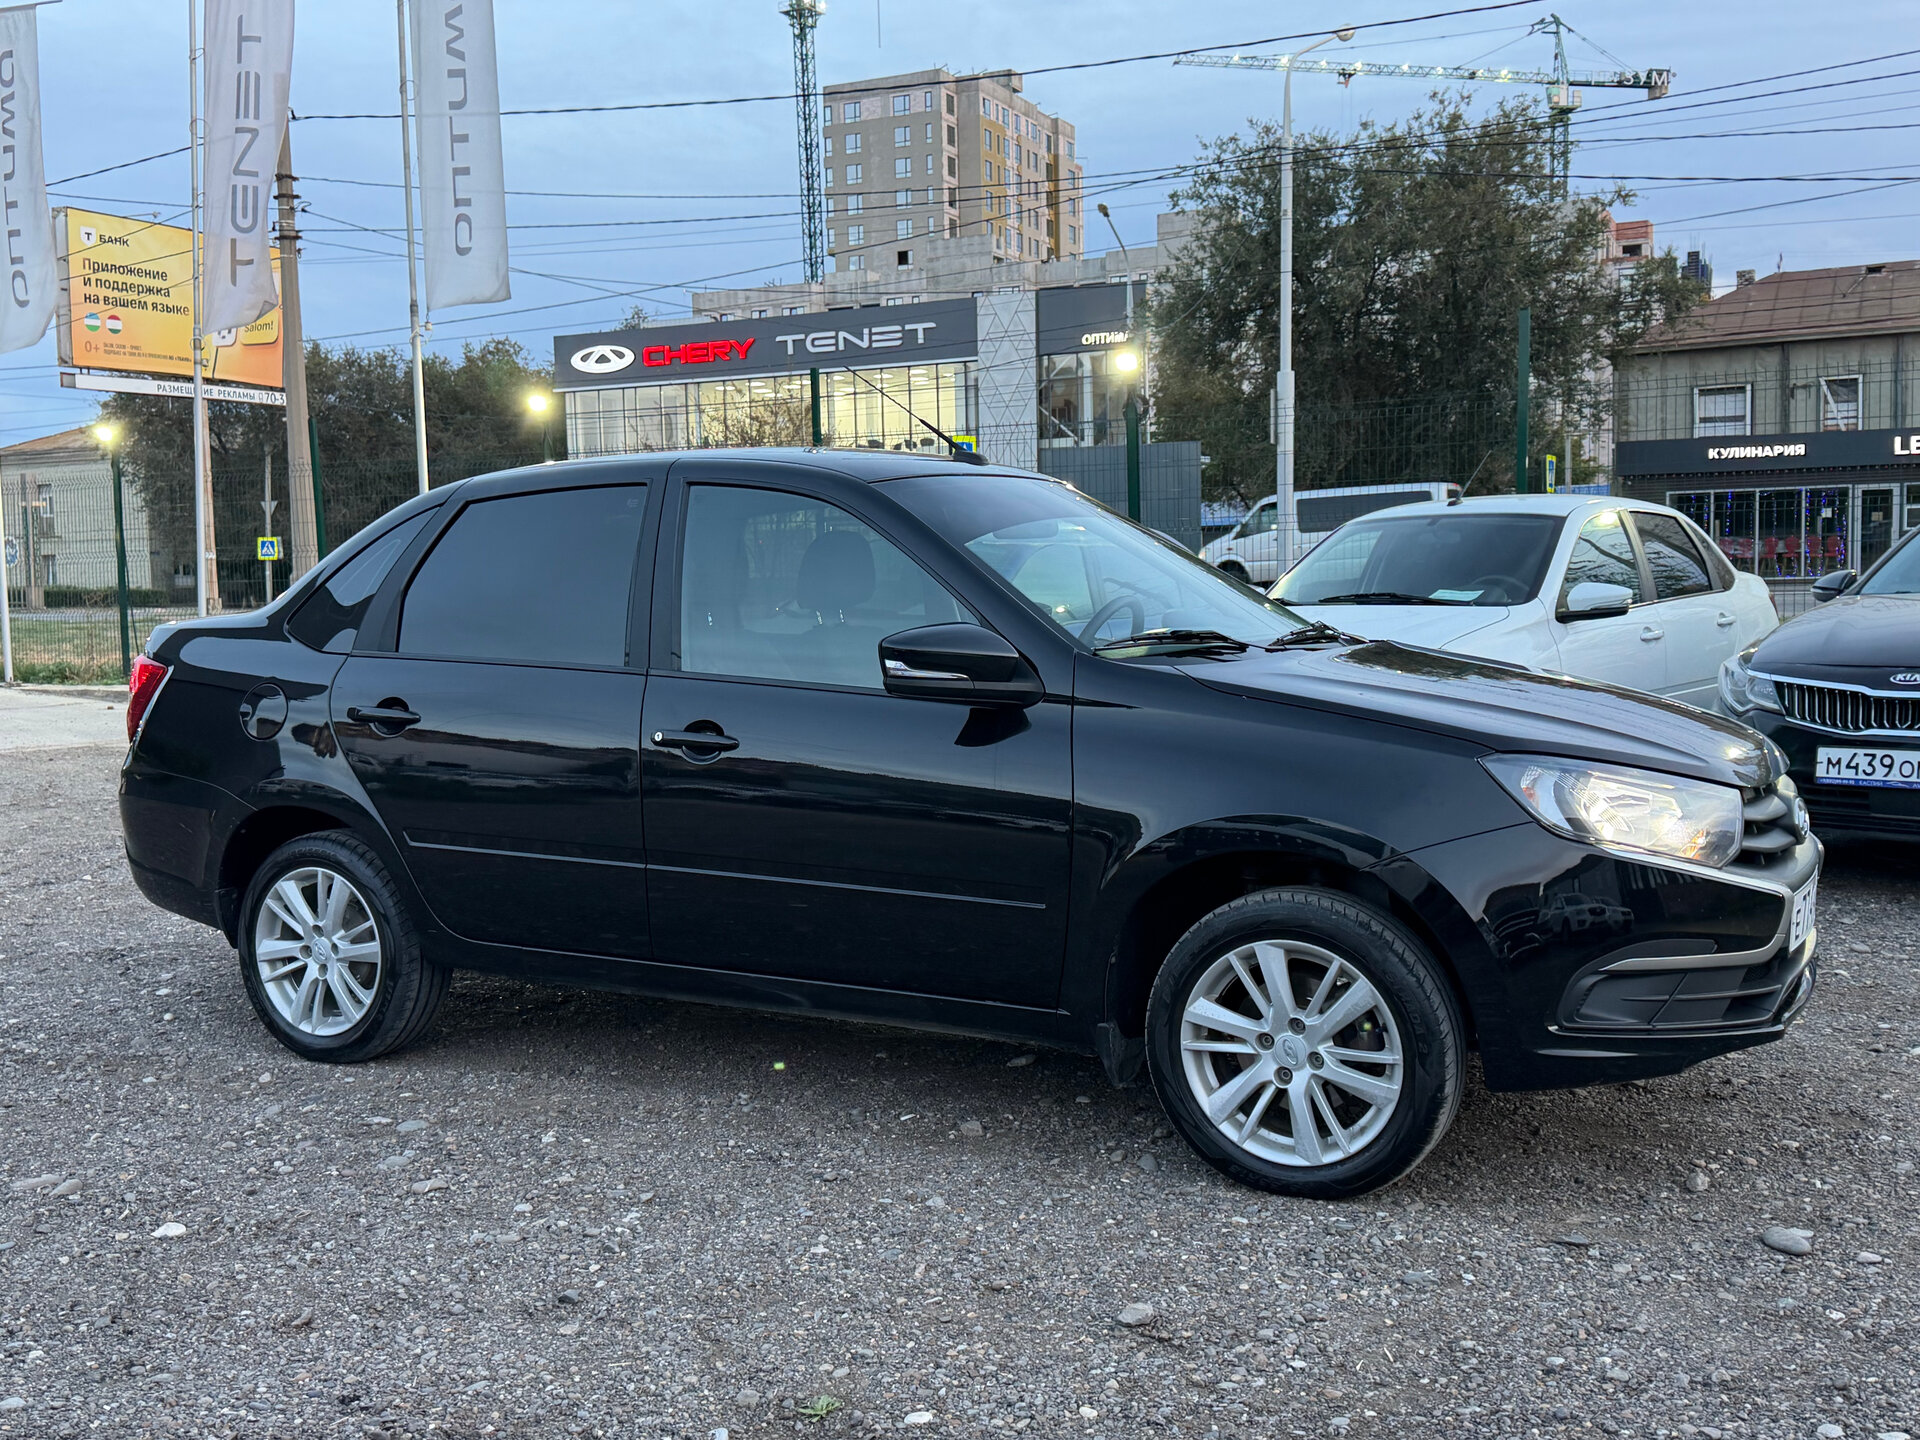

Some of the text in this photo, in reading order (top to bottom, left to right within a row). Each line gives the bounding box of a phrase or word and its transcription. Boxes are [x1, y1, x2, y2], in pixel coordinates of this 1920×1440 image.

[230, 14, 261, 287] TENET
[99, 234, 130, 247] БАНК
[83, 258, 168, 281] Приложение
[83, 277, 170, 298] и поддержка
[84, 293, 190, 316] на вашем языке
[642, 322, 937, 367] CHERY TENET
[156, 383, 214, 397] РАЗМЕЩИЕ
[217, 388, 256, 400] РЕКЛАМЫ
[1708, 443, 1806, 460] КУЛИНАРИЯ
